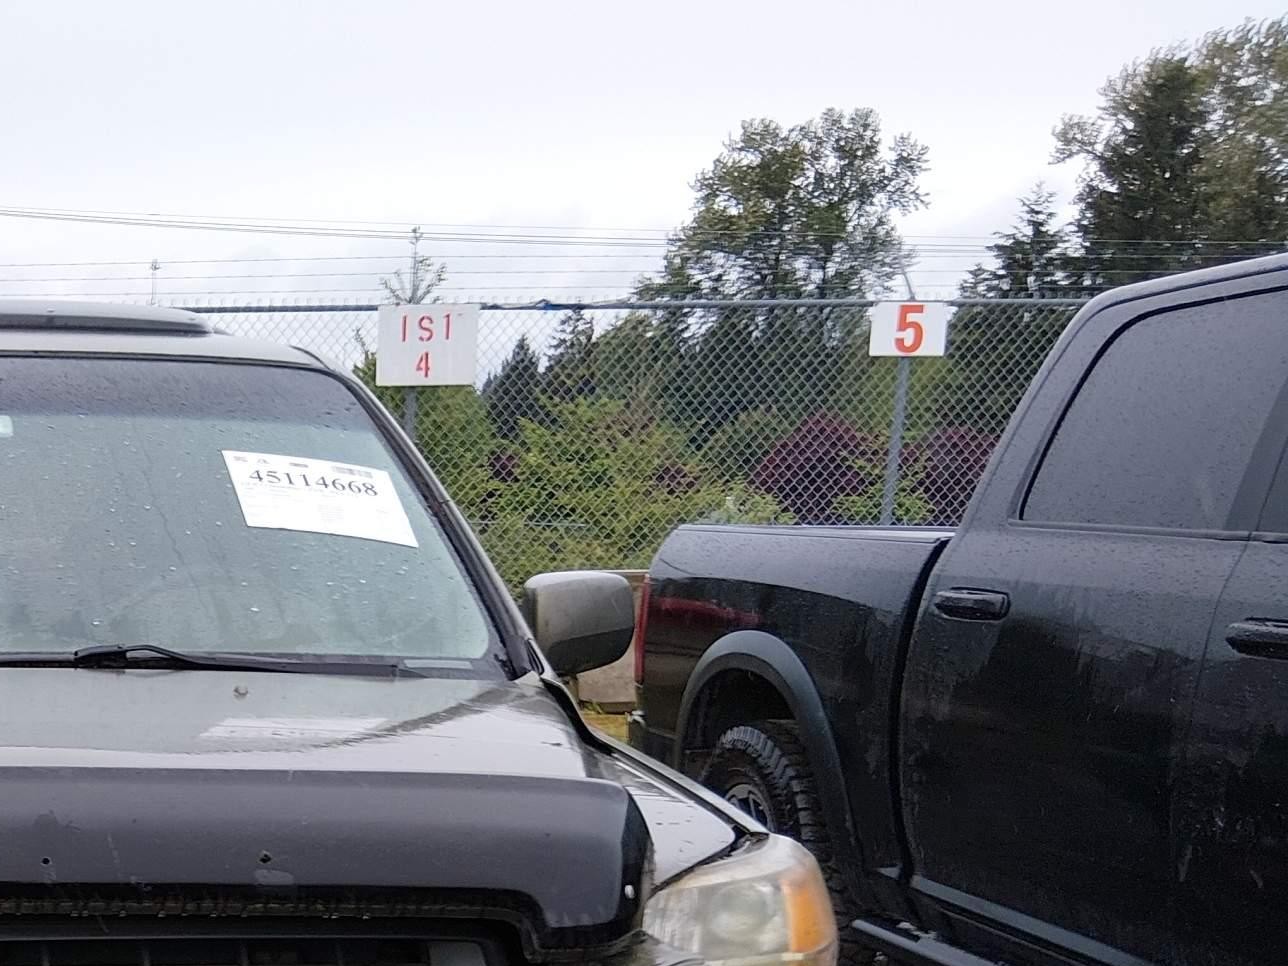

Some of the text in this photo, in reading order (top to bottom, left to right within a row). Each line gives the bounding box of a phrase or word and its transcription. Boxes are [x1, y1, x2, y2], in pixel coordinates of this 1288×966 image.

[894, 304, 924, 353] 5
[415, 351, 431, 378] 4
[249, 469, 379, 497] 45114668
